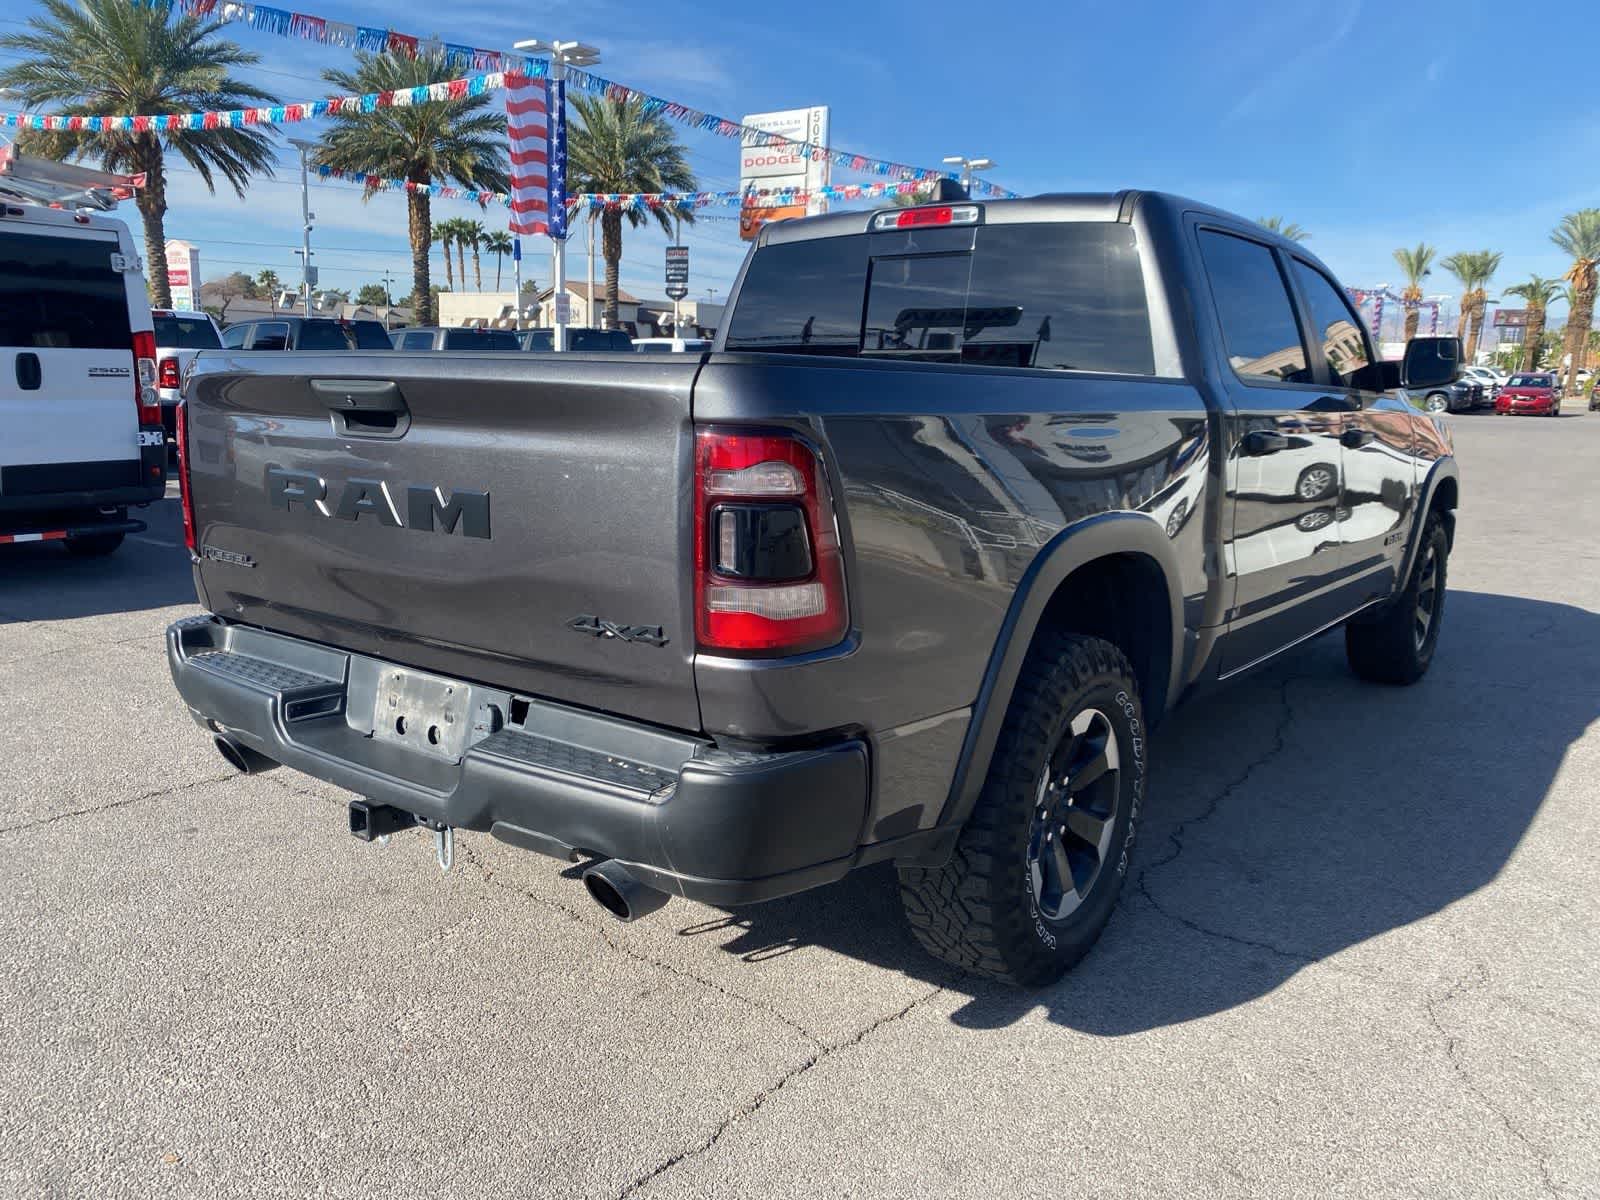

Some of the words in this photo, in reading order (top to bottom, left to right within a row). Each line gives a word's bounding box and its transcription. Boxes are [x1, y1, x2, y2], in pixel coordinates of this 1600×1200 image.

[744, 155, 801, 168] DODGE
[266, 466, 492, 540] RAM
[202, 545, 257, 568] REBEL
